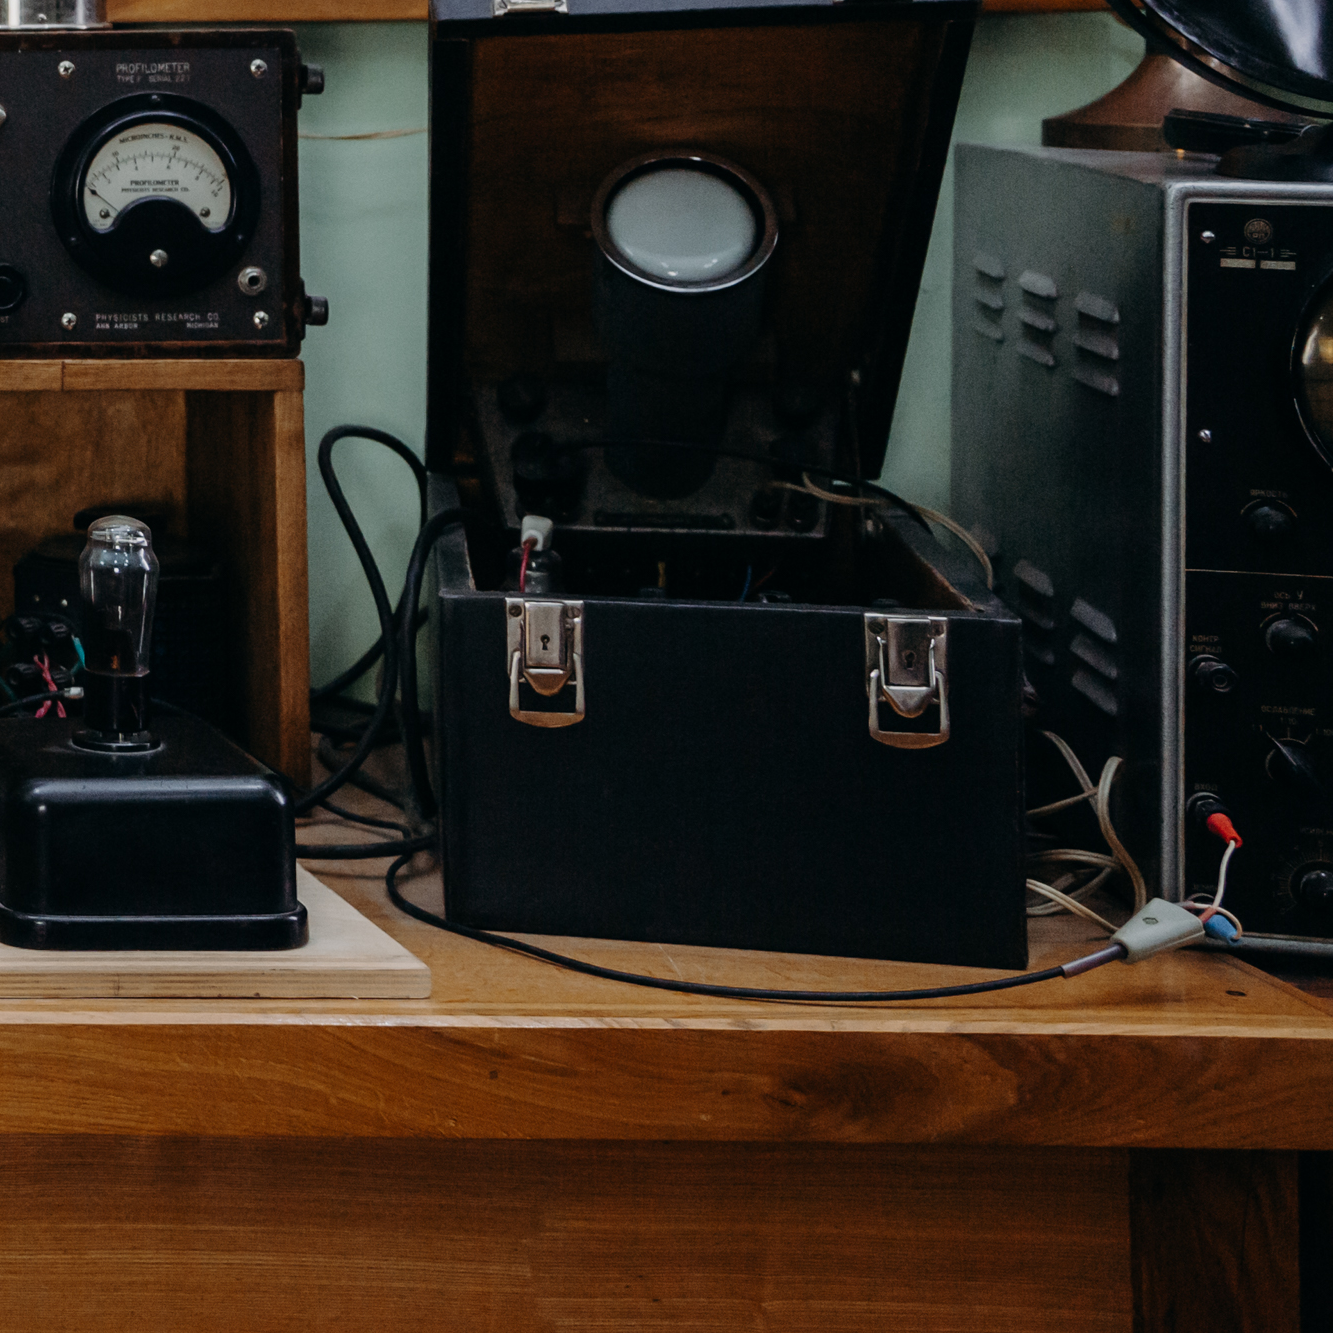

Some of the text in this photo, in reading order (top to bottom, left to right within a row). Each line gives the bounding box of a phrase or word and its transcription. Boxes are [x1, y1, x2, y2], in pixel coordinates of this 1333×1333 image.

[116, 62, 190, 73] PROFILOMETER
[95, 312, 149, 322] PHYSICISTS
[154, 312, 201, 322] RESEARCH
[95, 321, 219, 330] ANN ARBOR MICHIGAN
[1194, 782, 1218, 791] ВХОД
